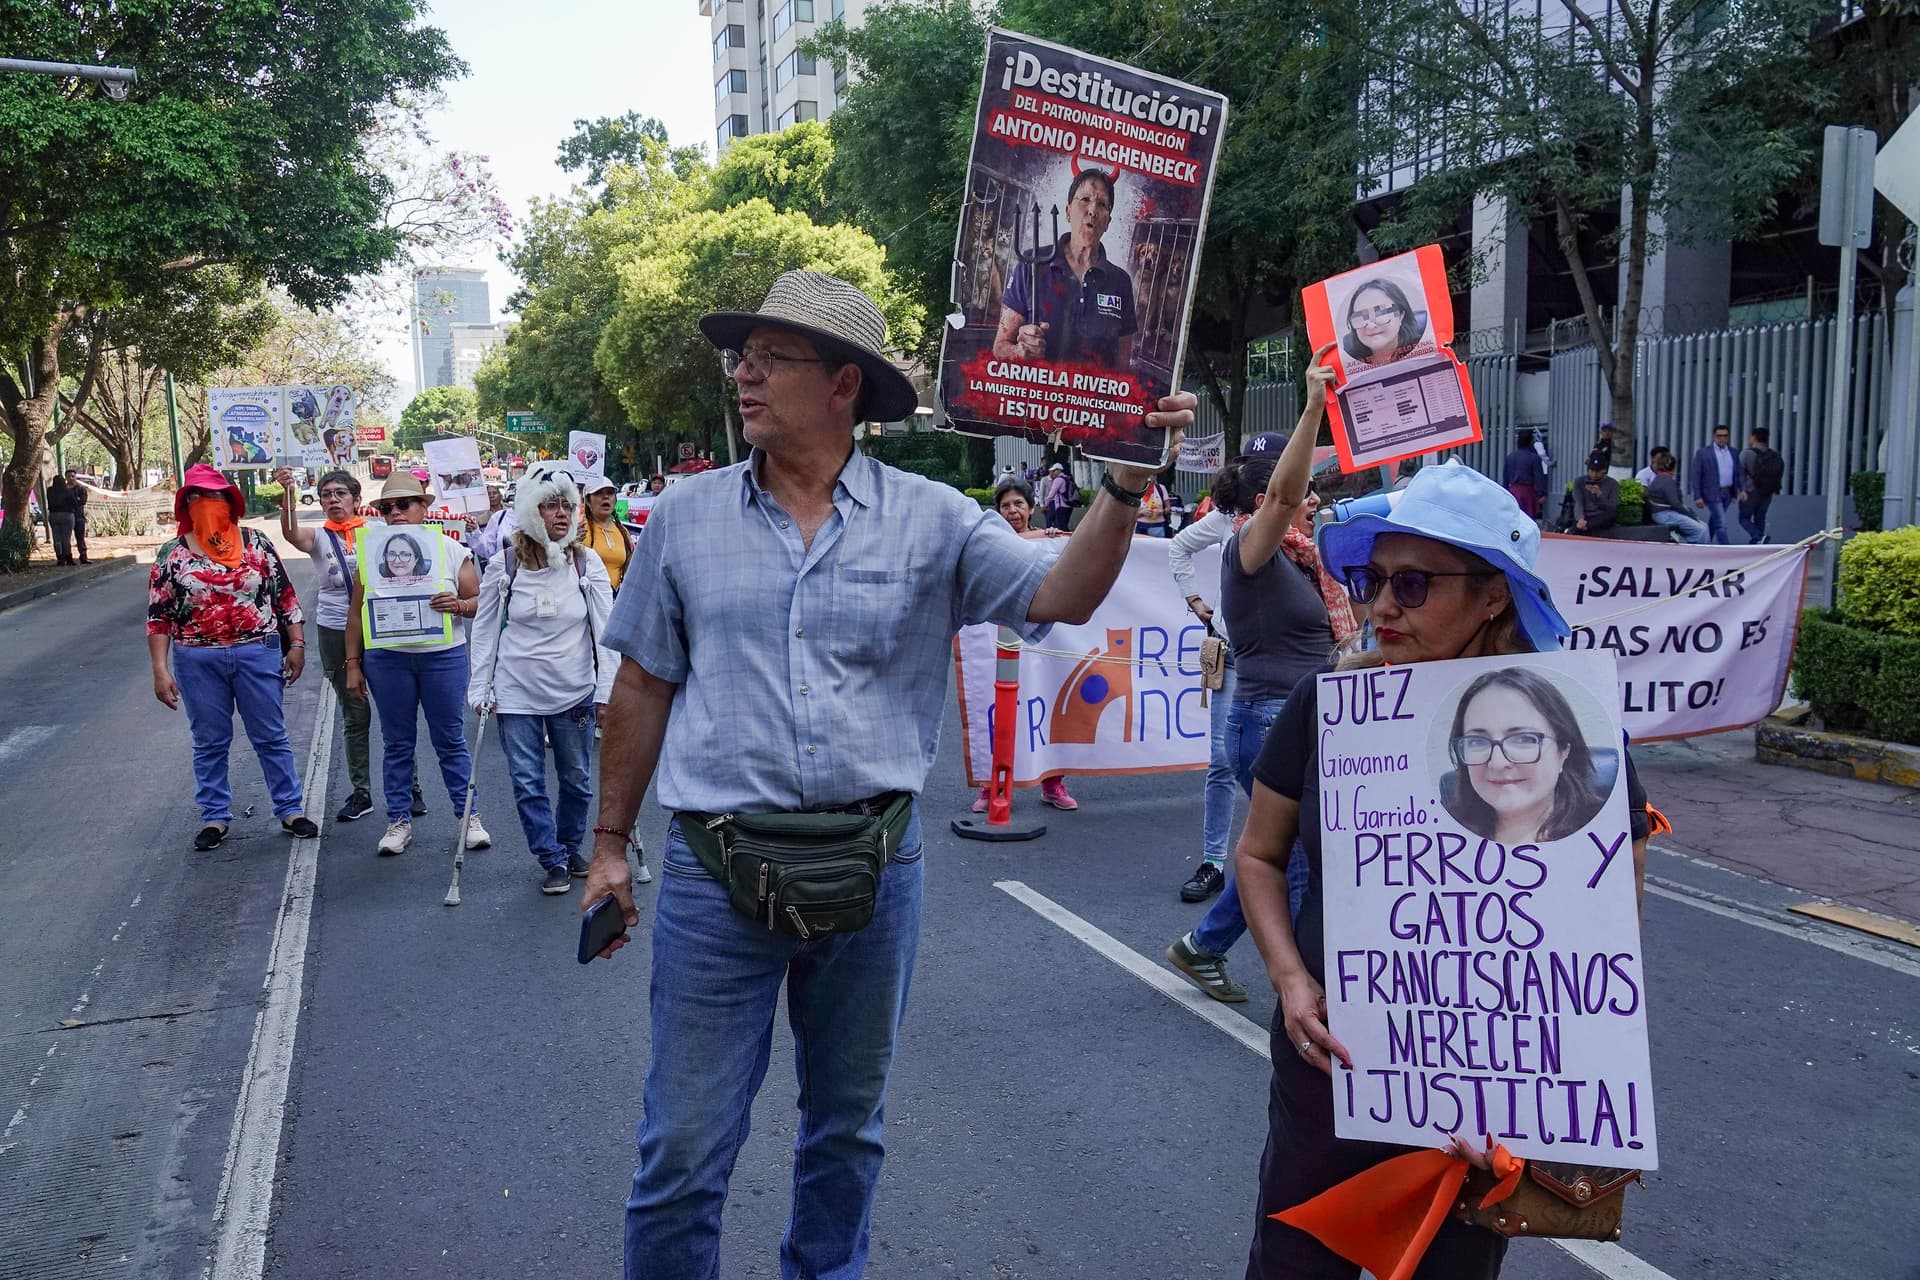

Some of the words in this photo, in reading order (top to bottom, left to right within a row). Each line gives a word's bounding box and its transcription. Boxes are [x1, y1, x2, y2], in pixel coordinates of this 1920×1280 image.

[1002, 50, 1212, 136] ¡Destitución!
[992, 113, 1077, 151] ANTONIO
[1080, 135, 1198, 184] HAGHENBECK
[1015, 95, 1038, 114] DEL
[1041, 100, 1113, 132] PATRONATO
[1115, 118, 1186, 151] FUNDACIÓN
[970, 380, 983, 391] LA
[985, 382, 1027, 398] MUERTE
[1029, 389, 1043, 400] DE
[1044, 391, 1064, 403] LOS
[1066, 394, 1144, 415] FRANCISCANITOS
[987, 361, 1069, 387] CARMELA
[1073, 373, 1130, 397] RIVERO
[999, 398, 1025, 417] ¡ES
[1028, 402, 1049, 420] TU
[1052, 406, 1105, 429] CULPA!
[1575, 566, 1745, 605] ¡SALVAR
[1659, 622, 1723, 653] NO
[1740, 615, 1771, 650] ES
[1321, 668, 1415, 726] JUEZ
[1320, 728, 1409, 780] Giovanna
[1323, 793, 1348, 833] U.
[1353, 785, 1439, 832] Garrido:
[1355, 832, 1548, 890] PERROS
[1587, 831, 1628, 889] Y
[1389, 890, 1545, 950] GATOS
[1337, 949, 1640, 1018] FRANCISCANOS
[1386, 1009, 1561, 1075] MERECEN
